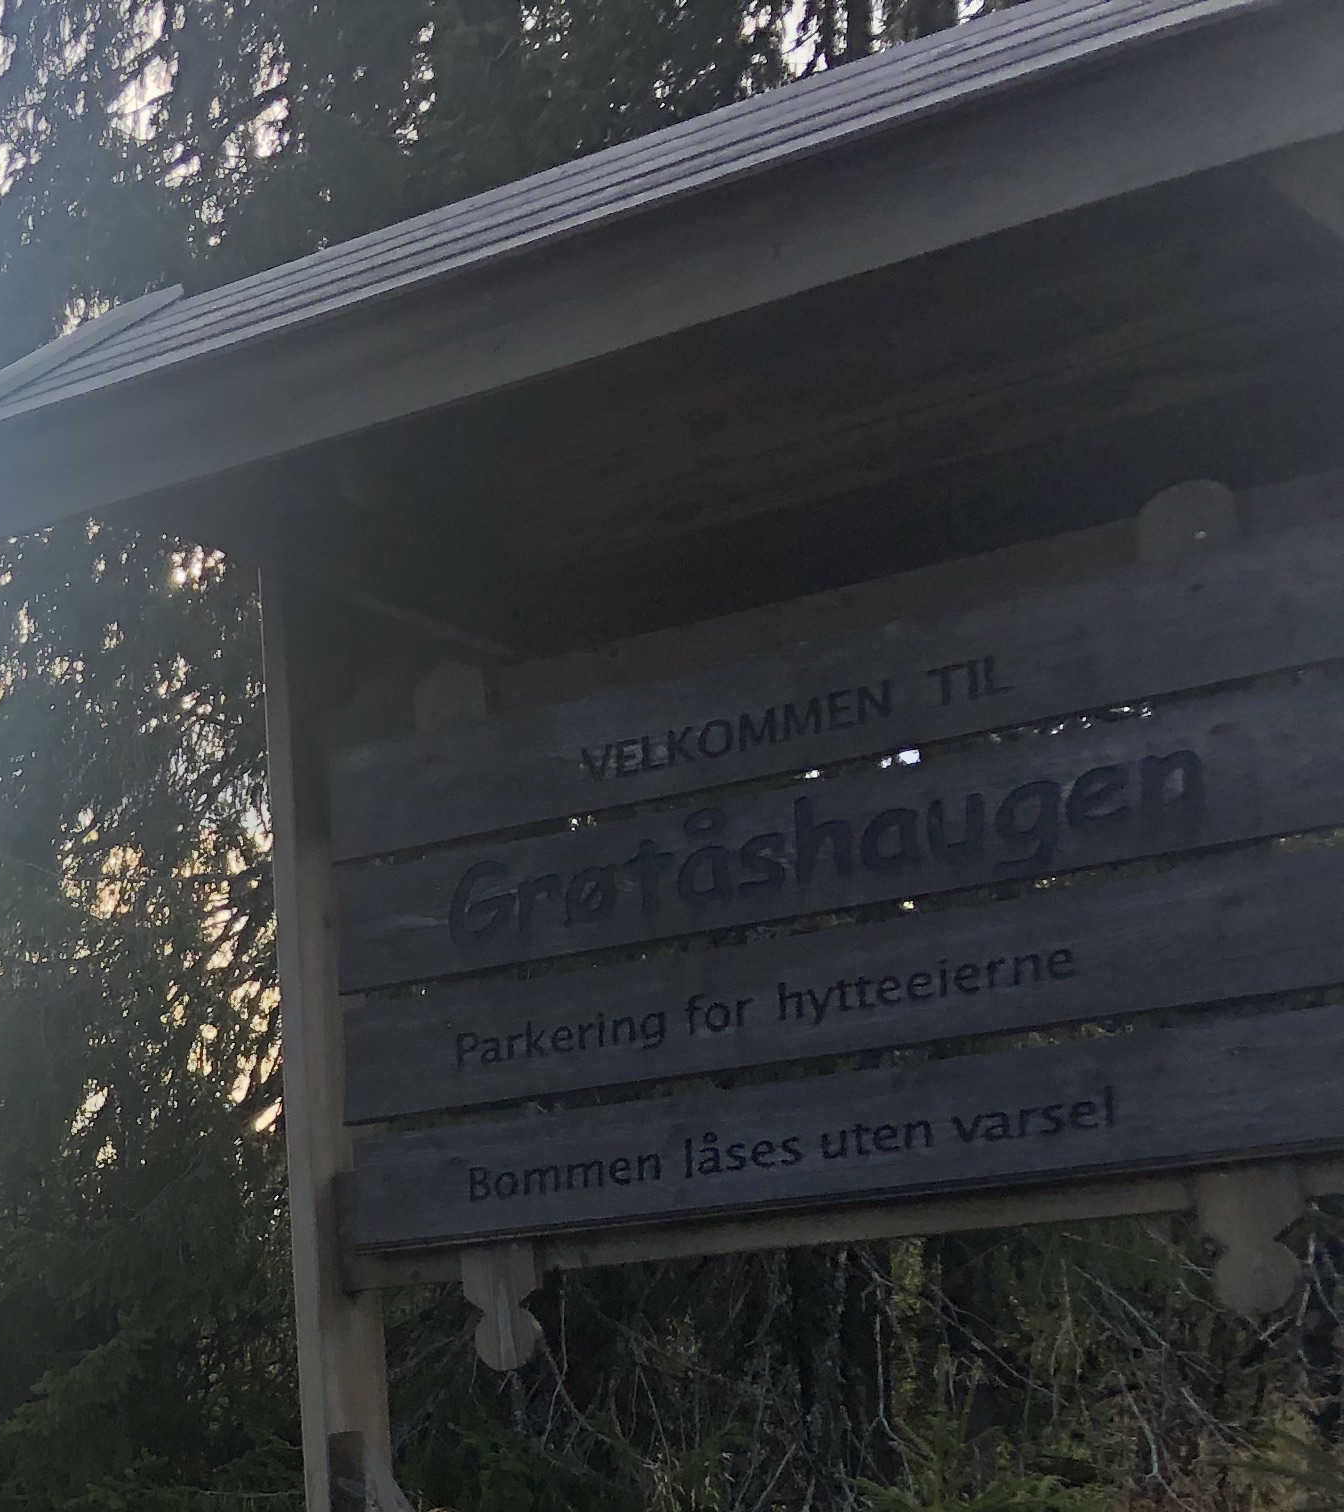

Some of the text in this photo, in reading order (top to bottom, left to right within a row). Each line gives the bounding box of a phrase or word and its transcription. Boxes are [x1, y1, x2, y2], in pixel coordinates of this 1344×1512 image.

[580, 655, 1013, 782] VELKOMMEN TIL
[448, 747, 1207, 946] Grøtåshaugen
[455, 944, 1075, 1068] Parkering for hytteeierne
[468, 1086, 1117, 1202] Bommen låses uten varsel
